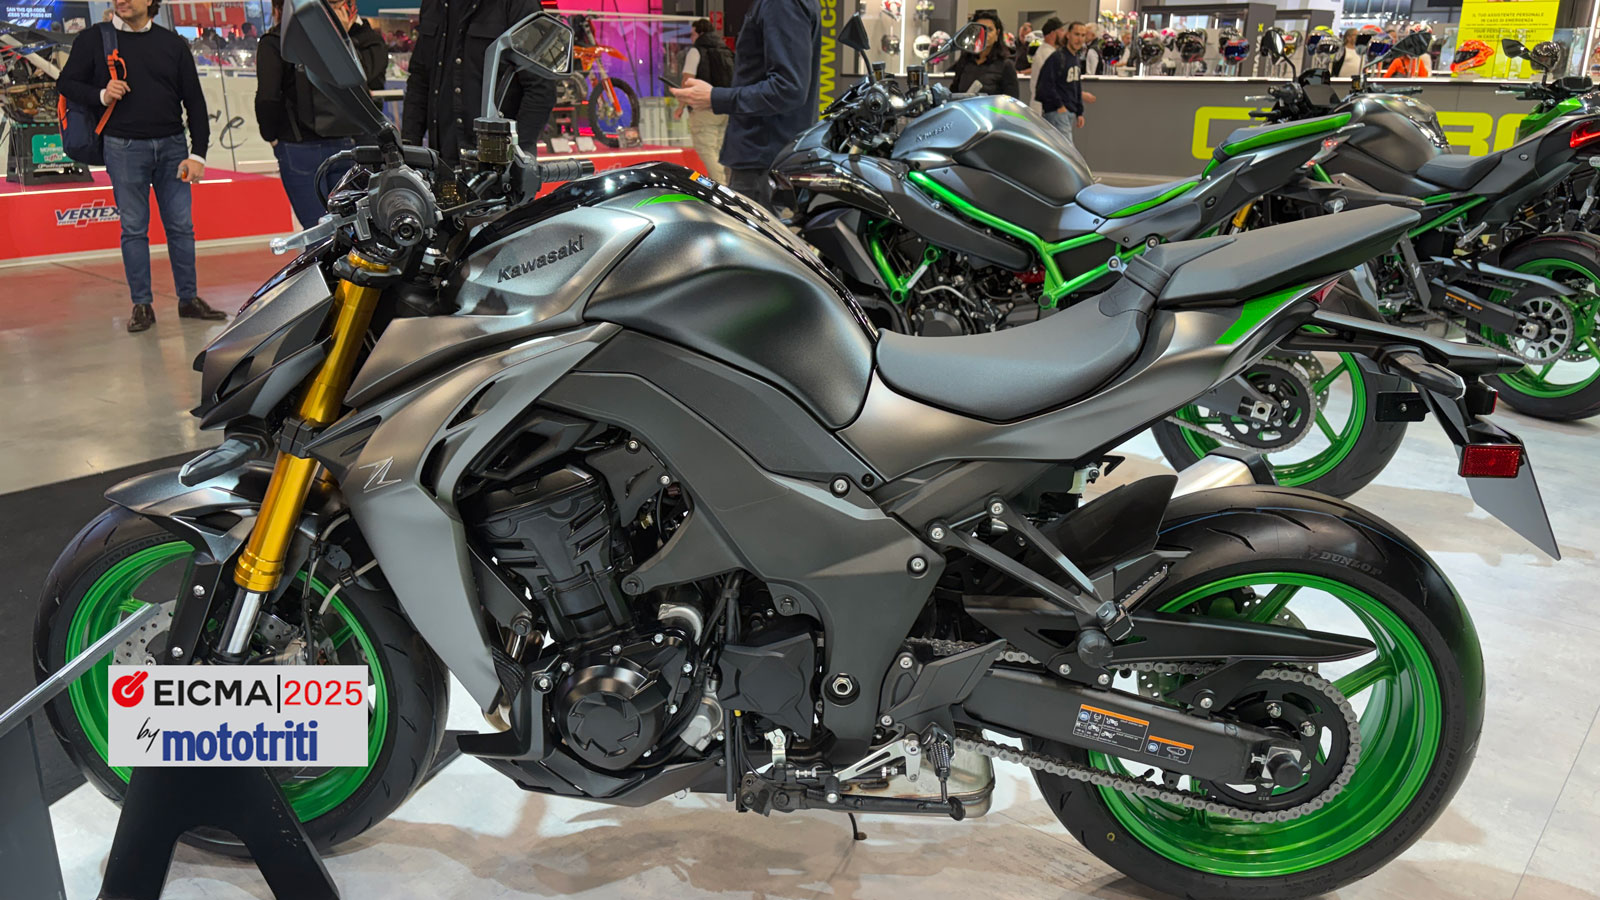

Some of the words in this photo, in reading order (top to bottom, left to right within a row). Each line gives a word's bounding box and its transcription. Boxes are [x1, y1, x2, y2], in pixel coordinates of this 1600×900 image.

[55, 207, 121, 221] VERTEX
[497, 233, 585, 283] Kawasaki
[1319, 551, 1383, 575] DUNLOP
